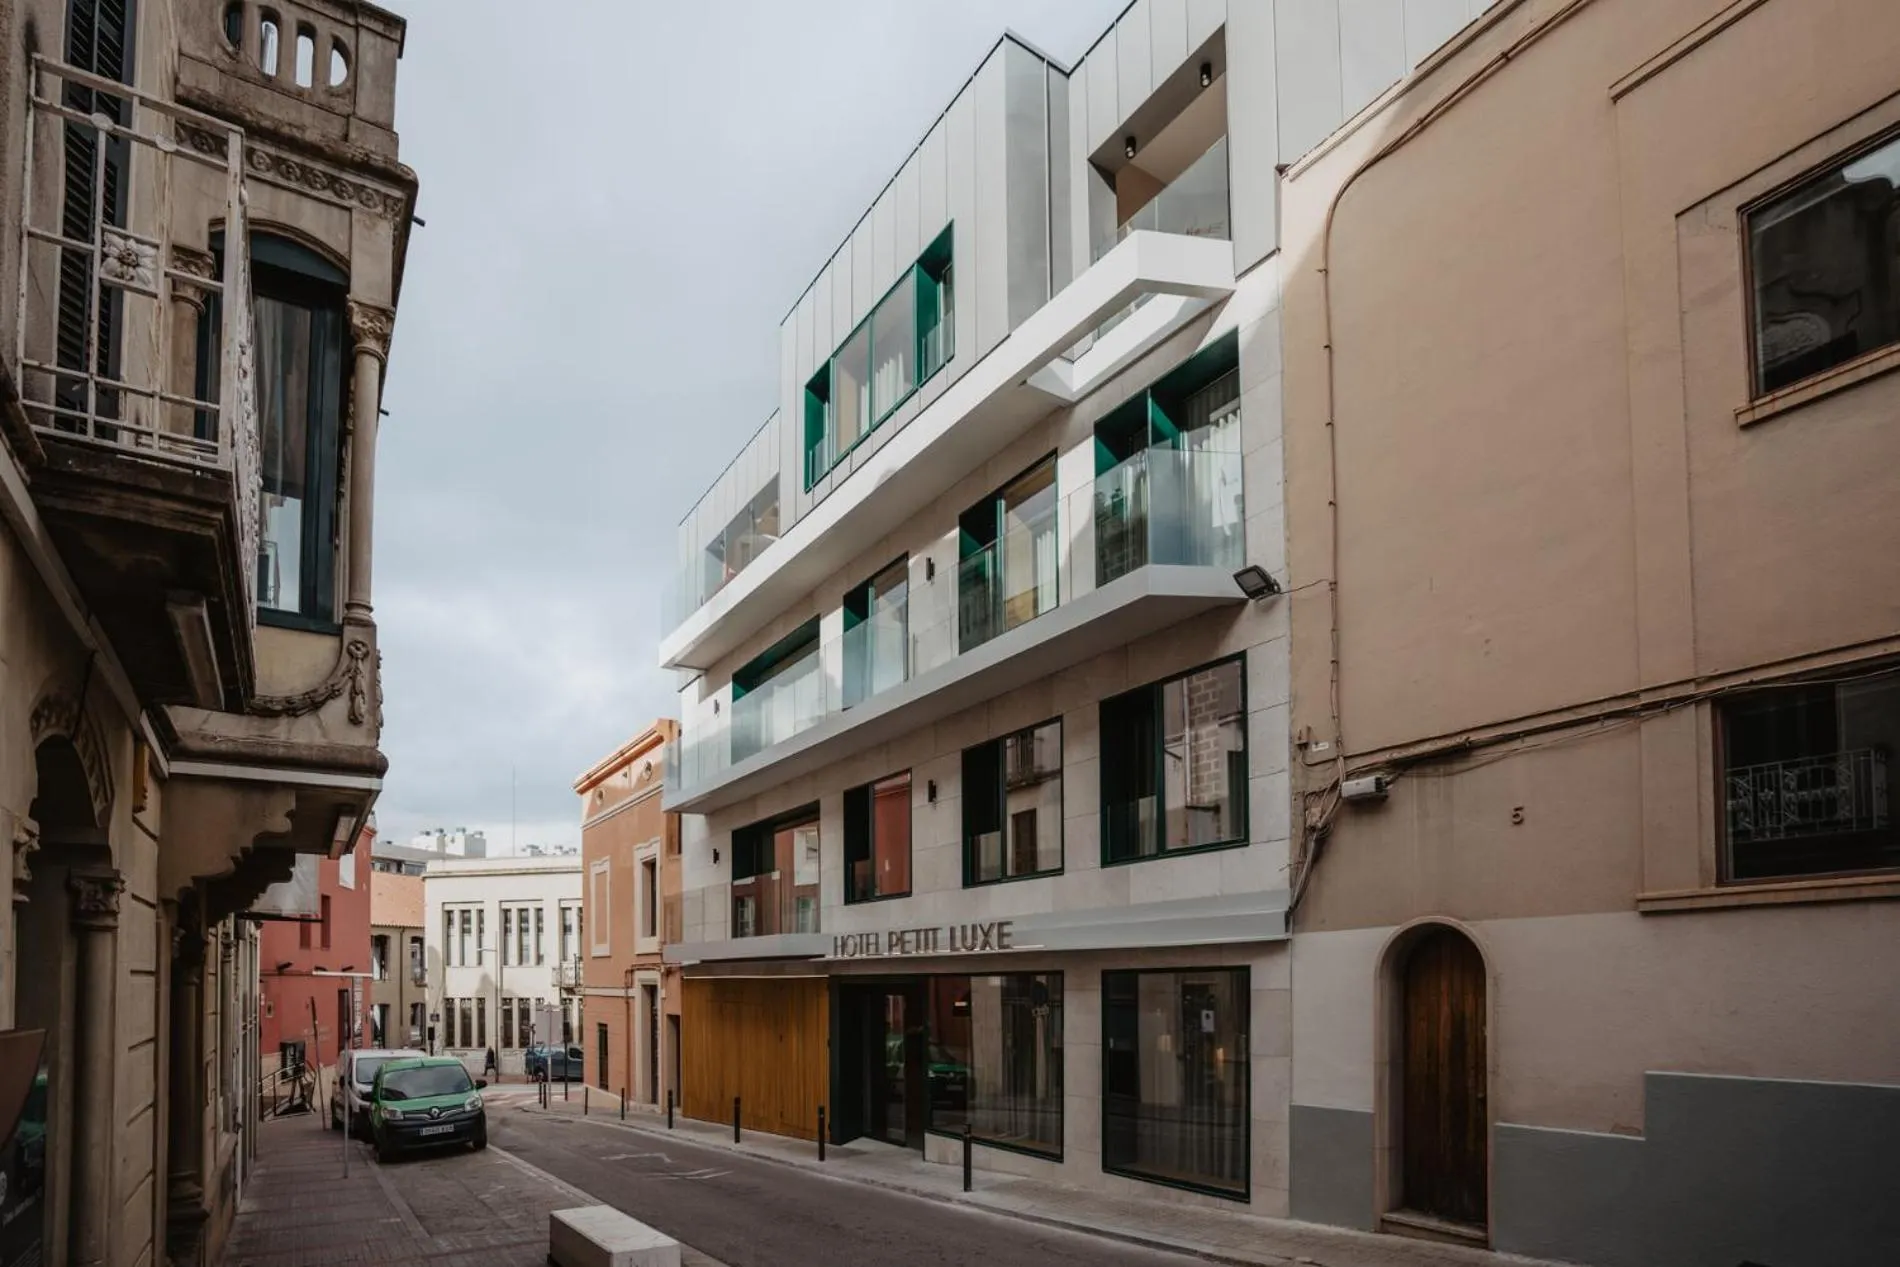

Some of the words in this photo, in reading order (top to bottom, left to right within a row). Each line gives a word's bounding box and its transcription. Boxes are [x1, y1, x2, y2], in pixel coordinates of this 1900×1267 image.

[1512, 806, 1525, 826] 5
[833, 932, 885, 957] HOTEL
[887, 927, 942, 955] PETIT
[949, 920, 1013, 952] LUXE
